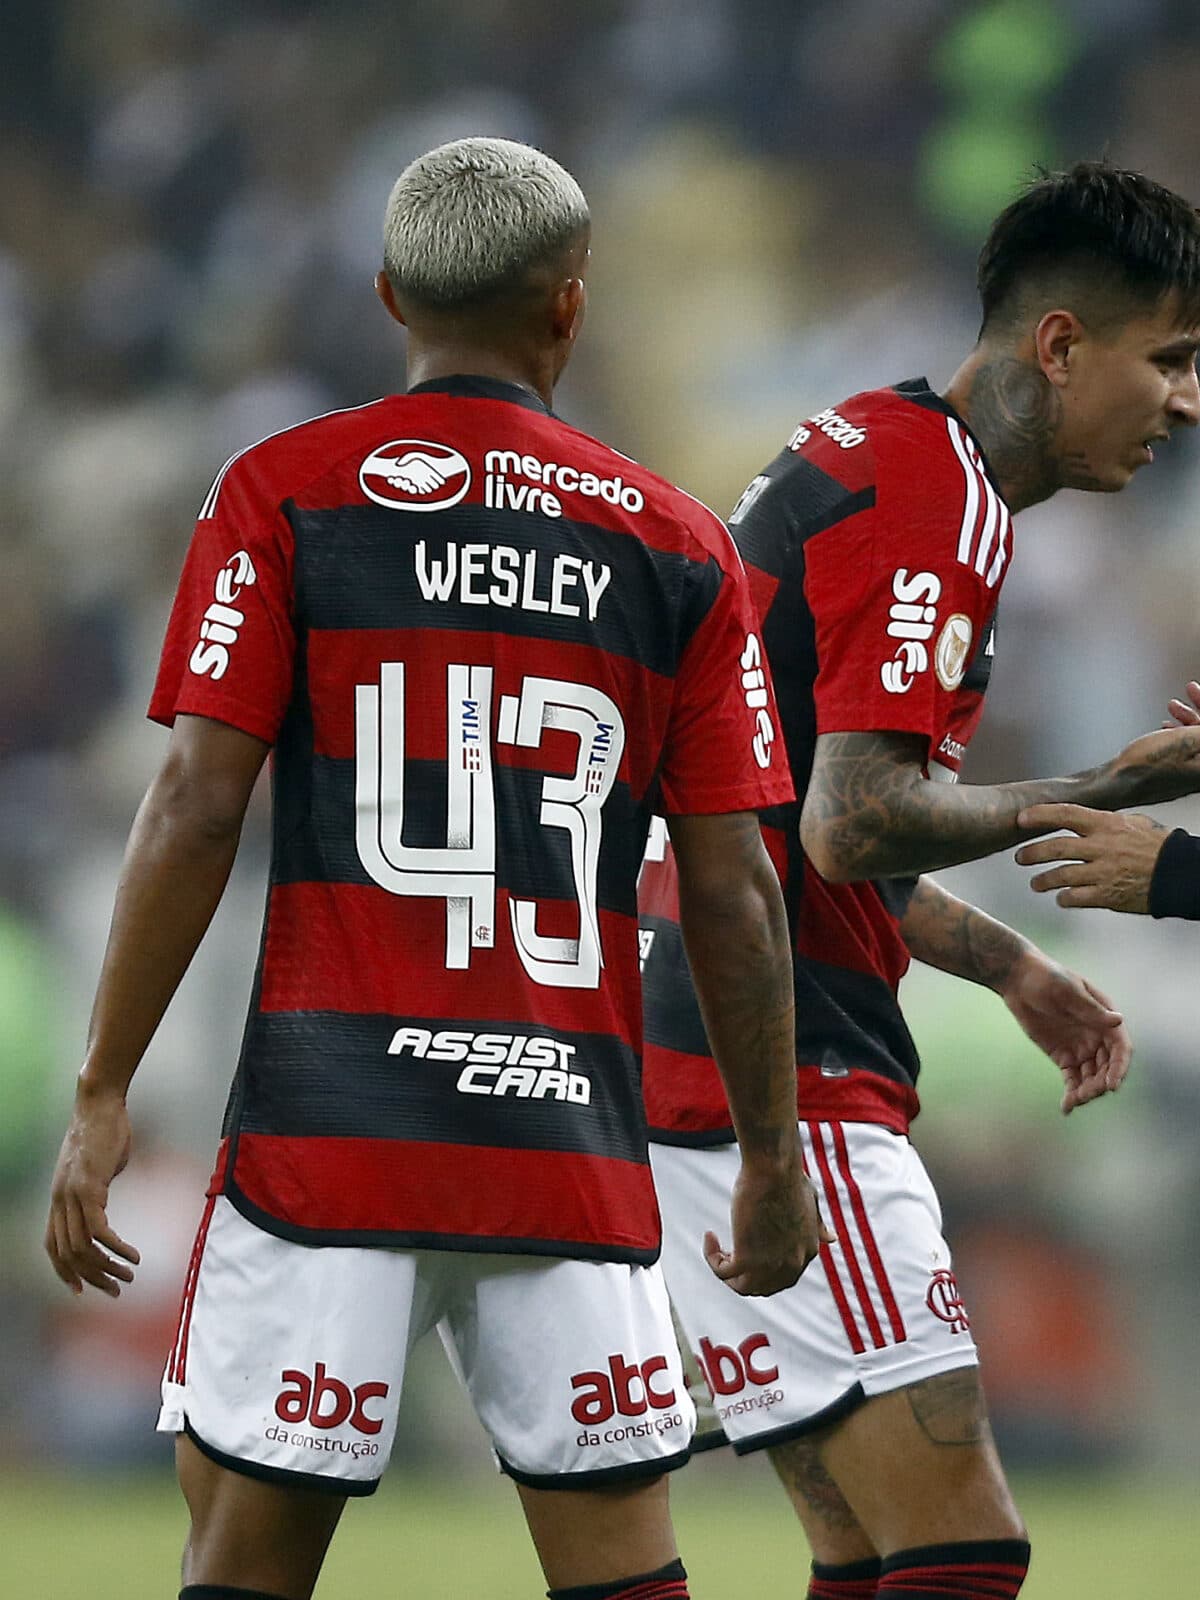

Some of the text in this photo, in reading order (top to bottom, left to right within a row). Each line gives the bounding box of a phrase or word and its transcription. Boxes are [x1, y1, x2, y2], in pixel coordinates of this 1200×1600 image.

[484, 449, 645, 514] mercado
[485, 473, 563, 519] livre
[414, 539, 612, 622] WESLEY
[461, 699, 480, 743] TIM
[588, 722, 616, 767] TIM
[355, 661, 627, 990] 43
[386, 1027, 577, 1071] ASSIST
[456, 1064, 591, 1106] CARD
[570, 1353, 677, 1425] abc
[694, 1332, 779, 1404] bc
[274, 1361, 390, 1435] abc
[265, 1425, 379, 1459] da construção
[576, 1430, 601, 1447] da
